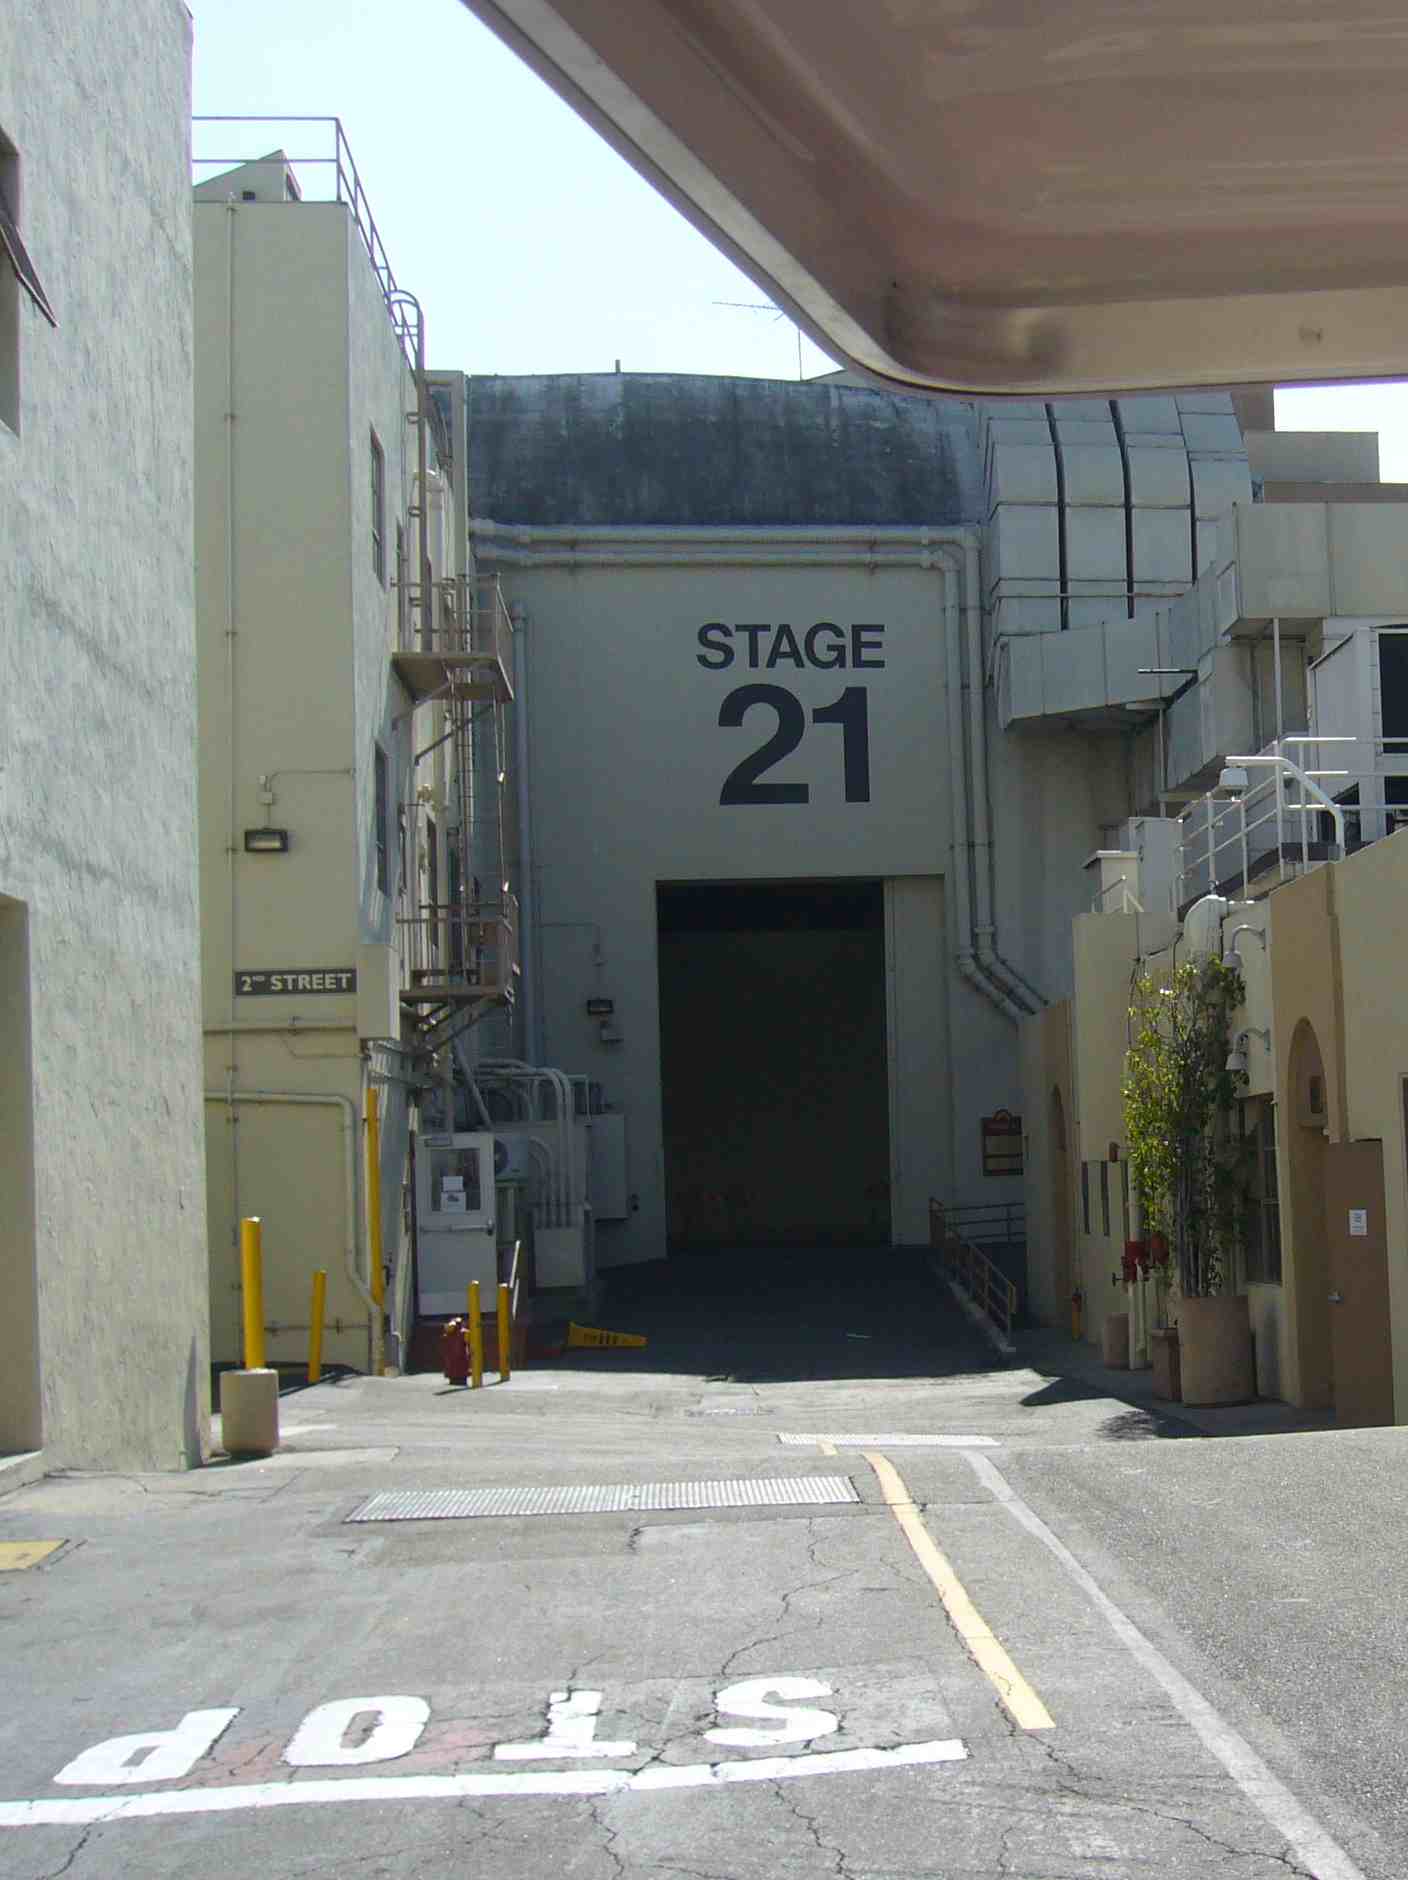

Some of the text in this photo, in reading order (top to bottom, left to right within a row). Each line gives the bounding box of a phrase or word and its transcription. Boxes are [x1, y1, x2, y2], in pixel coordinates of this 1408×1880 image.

[696, 622, 885, 670] STAGE
[718, 683, 870, 805] 21
[270, 973, 352, 990] STREET
[53, 1676, 839, 1786] STOP
